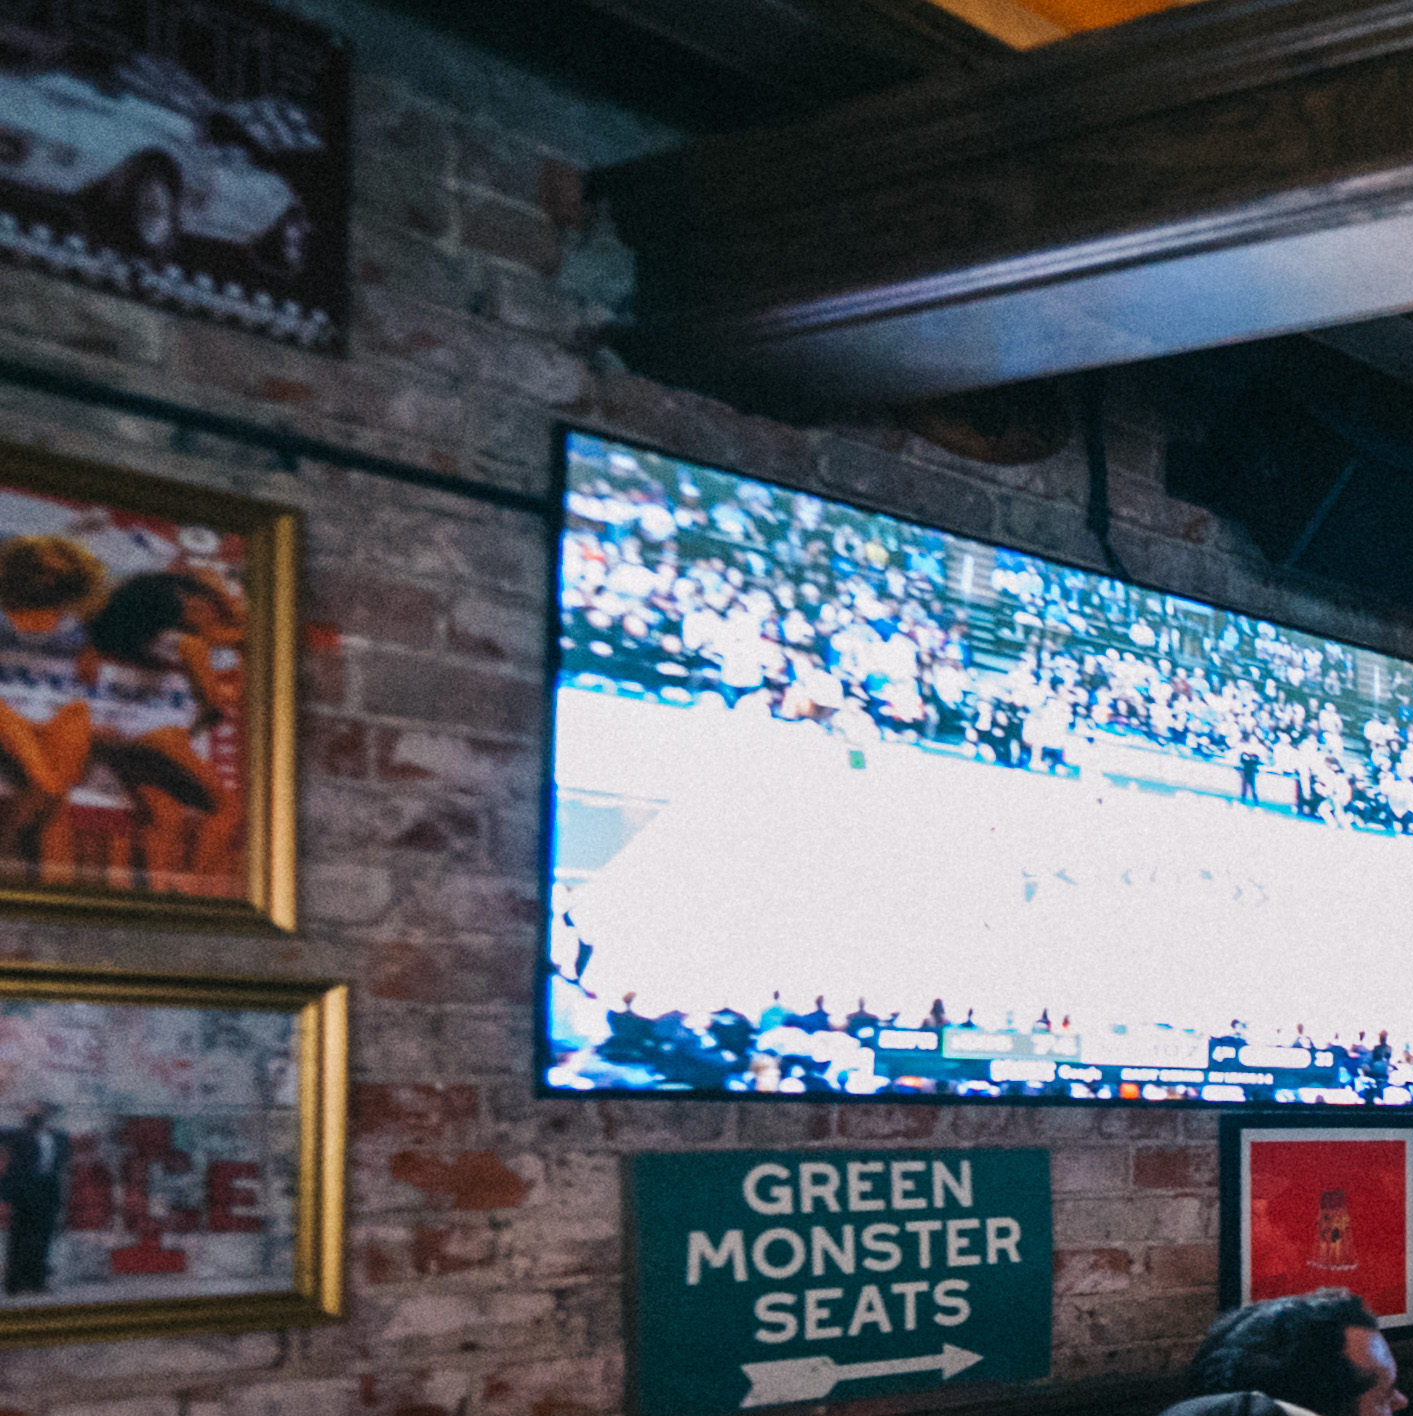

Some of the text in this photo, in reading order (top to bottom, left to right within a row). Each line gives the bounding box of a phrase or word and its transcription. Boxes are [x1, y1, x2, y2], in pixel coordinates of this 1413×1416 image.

[743, 1160, 974, 1216] GREEN
[686, 1217, 1022, 1286] MONSTER
[753, 1279, 971, 1344] SEATS
